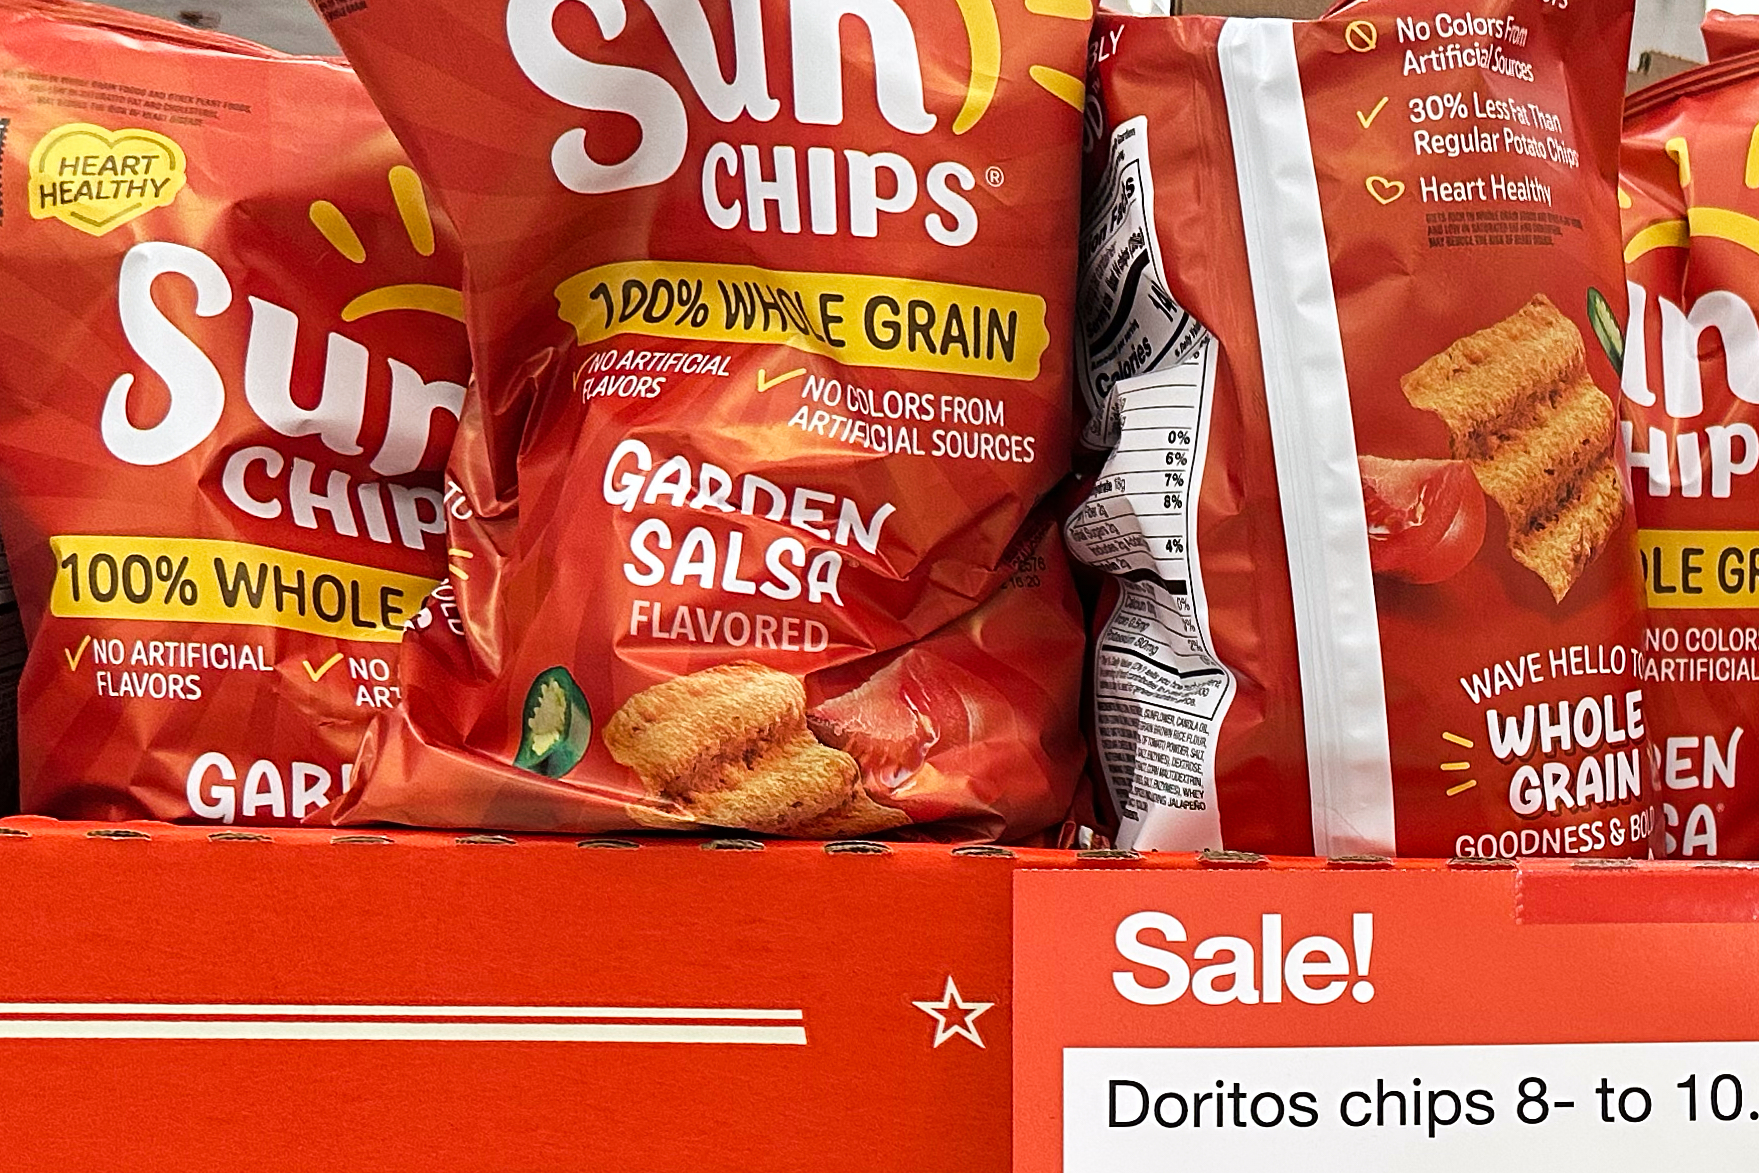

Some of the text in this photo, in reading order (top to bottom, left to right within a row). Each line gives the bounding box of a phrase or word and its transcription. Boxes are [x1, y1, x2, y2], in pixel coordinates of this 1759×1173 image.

[1397, 12, 1528, 47] No Colors From
[1403, 42, 1535, 82] Artificial Sources
[1409, 91, 1562, 134] 30% Less Fat Than
[59, 155, 160, 177] HEART
[1413, 126, 1580, 168] Regular Potato Chips
[40, 177, 171, 209] HEALTHY
[1420, 174, 1552, 207] Heart Healthy
[590, 278, 709, 331] 100%
[717, 279, 846, 347] WHOLE
[864, 294, 1019, 363] GRAIN
[588, 349, 732, 378] NO ARTIFICIAL
[582, 376, 667, 404] FLAVORS
[801, 374, 1006, 428] NO COLORS FROM
[787, 404, 1036, 464] ARTIFICIAL SOURCES
[1167, 430, 1191, 445] 0%
[1164, 473, 1184, 487] 7%
[1165, 451, 1187, 467] 6%
[221, 445, 448, 552] CHIP
[602, 438, 897, 556] GARDEN
[1163, 494, 1182, 509] 8%
[623, 517, 846, 607] SALSA
[1165, 539, 1184, 553] 4%
[61, 553, 405, 631] 100% WHOLE
[629, 599, 830, 654] FLAVORED
[1646, 628, 1679, 652] NO
[93, 638, 274, 672] NO ARTIFICIAL
[349, 657, 390, 682] NO
[1460, 652, 1545, 704] WAVE
[1549, 644, 1626, 679] HELLO
[97, 672, 202, 701] FLAVORS
[1486, 689, 1645, 759] WHOLE
[187, 751, 353, 824] GAR
[1509, 748, 1641, 816] GRAIN
[1455, 820, 1605, 859] GOODNESS
[1609, 817, 1626, 846] &
[1112, 910, 1375, 1006] Sale!
[1108, 1079, 1319, 1129] Doritos
[1339, 1077, 1496, 1138] chips
[1516, 1076, 1574, 1124] 8-
[1595, 1077, 1653, 1123] to
